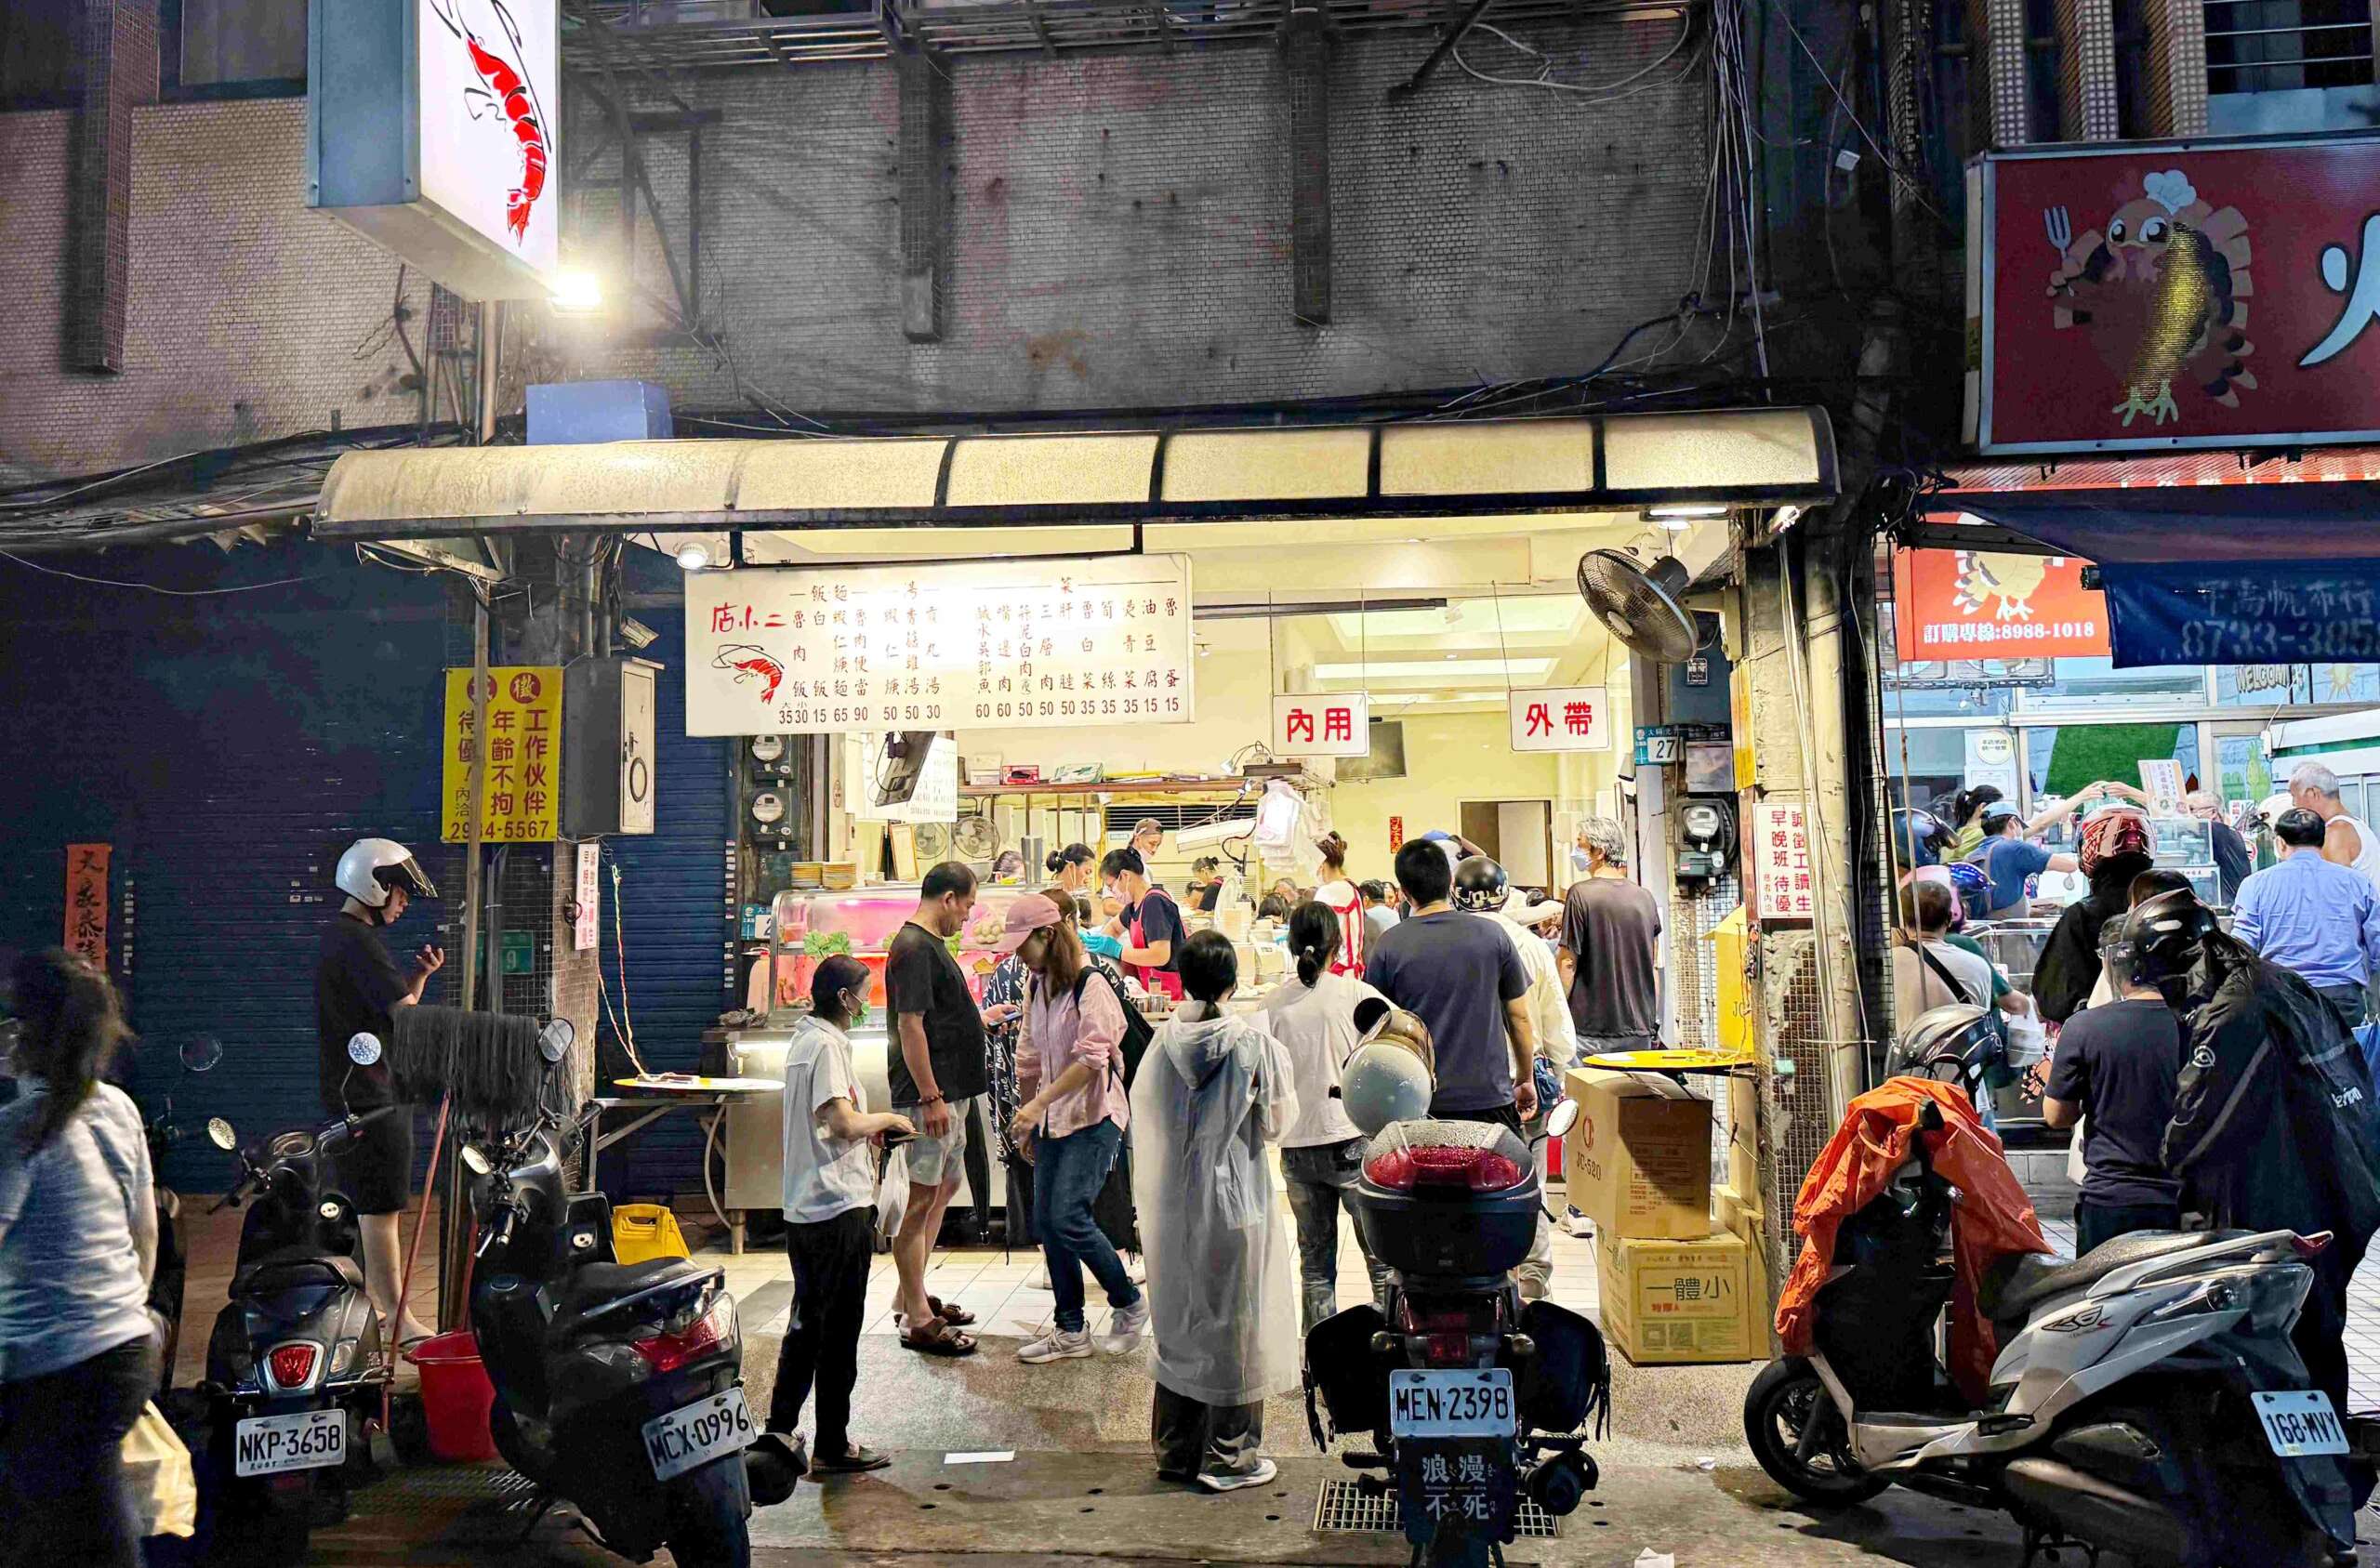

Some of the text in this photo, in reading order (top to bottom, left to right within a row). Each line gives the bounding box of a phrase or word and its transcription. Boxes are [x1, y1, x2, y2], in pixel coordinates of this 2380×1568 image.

[1923, 621, 2095, 643] 訂購專線:8988-1018
[976, 704, 990, 718] 60
[998, 703, 1011, 717] 60
[1019, 702, 1033, 716] 50
[1040, 702, 1053, 715] 50
[1062, 701, 1075, 714] 50
[1081, 700, 1095, 714] 35
[1102, 700, 1116, 713] 35
[1124, 699, 1138, 713] 35
[1144, 698, 1157, 712] 15
[1166, 697, 1179, 711] 15
[779, 710, 792, 724] 35
[795, 709, 808, 723] 30
[813, 708, 826, 723] 15
[834, 708, 848, 721] 65
[854, 706, 868, 720] 90
[883, 706, 897, 720] 50
[906, 705, 919, 719] 50
[927, 705, 940, 718] 30
[1526, 701, 1593, 736] 外帶
[1287, 707, 1351, 743] 內用
[1656, 740, 1675, 758] 27
[491, 709, 515, 816] 年齡不拘
[523, 709, 548, 816] 工作伙伴
[451, 820, 549, 839] 294-5567
[1771, 810, 1791, 913] 早晚班待優
[1422, 1454, 1486, 1482] 浪漫
[1424, 1493, 1489, 1522] 不死
